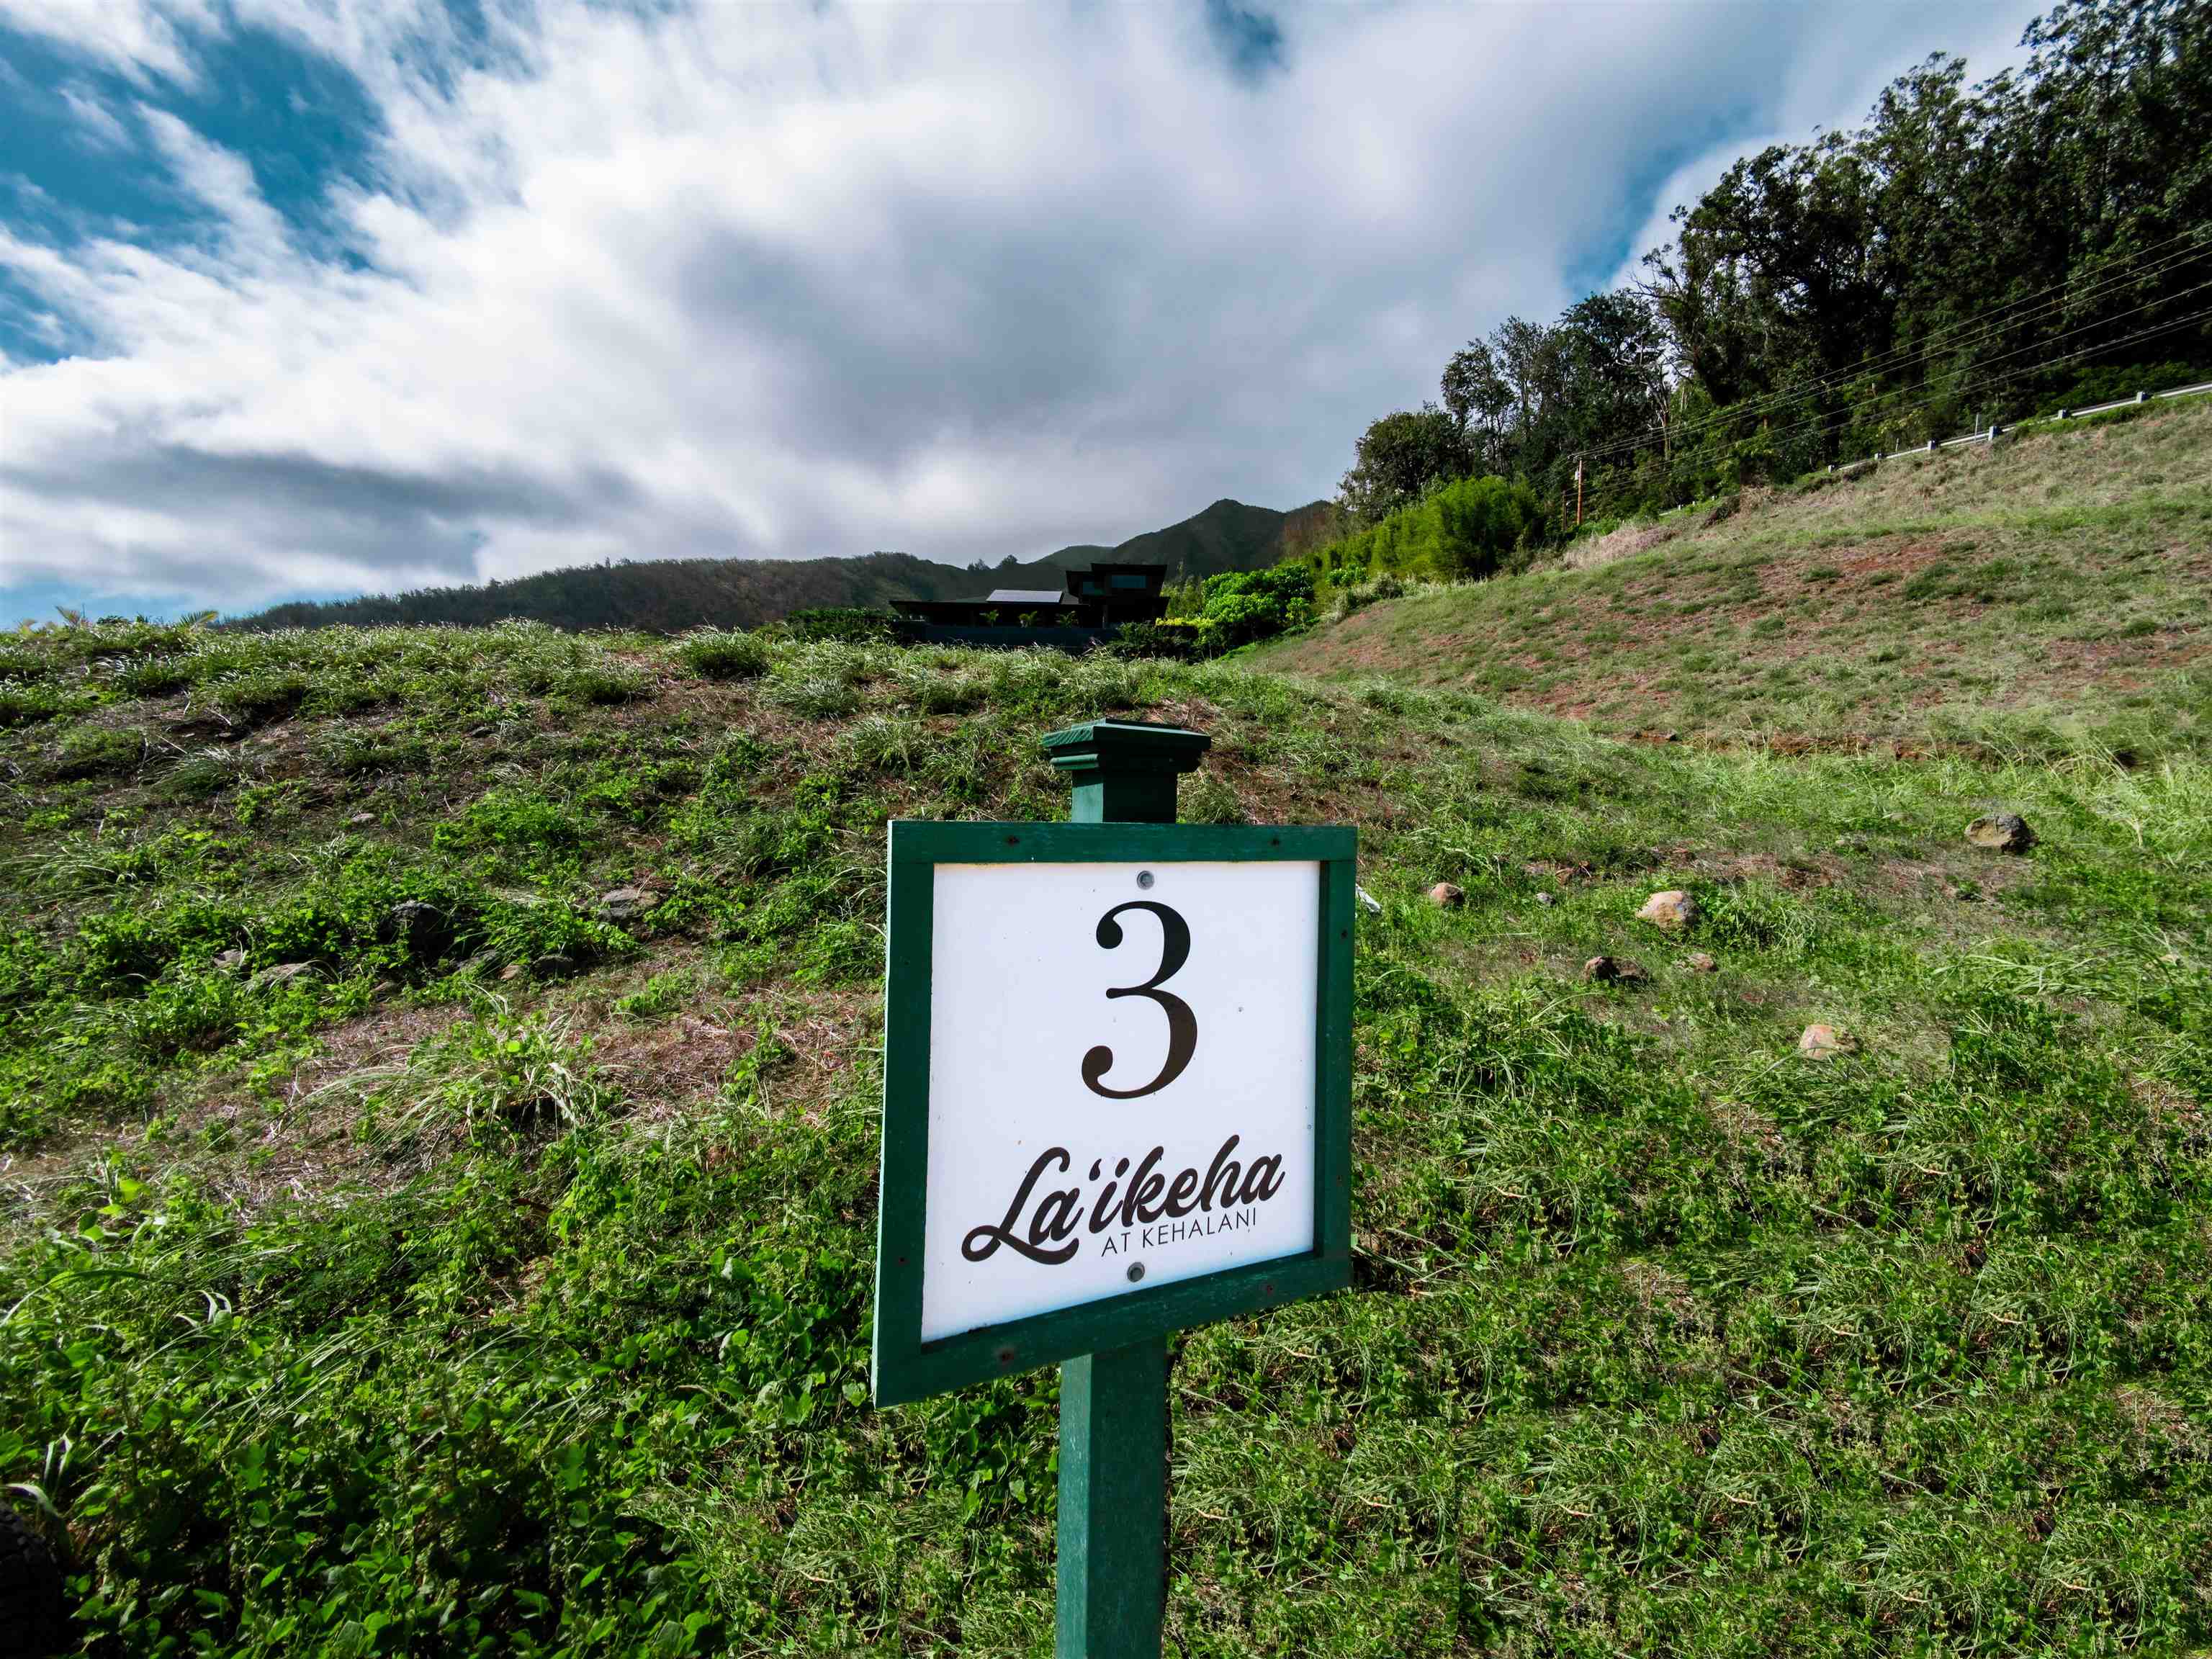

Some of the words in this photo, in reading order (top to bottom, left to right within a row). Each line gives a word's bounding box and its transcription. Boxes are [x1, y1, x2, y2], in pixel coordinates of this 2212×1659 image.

[1082, 901, 1198, 1100] 3
[1101, 1232, 1131, 1257] AT
[1142, 1207, 1257, 1249] KEHALANI
